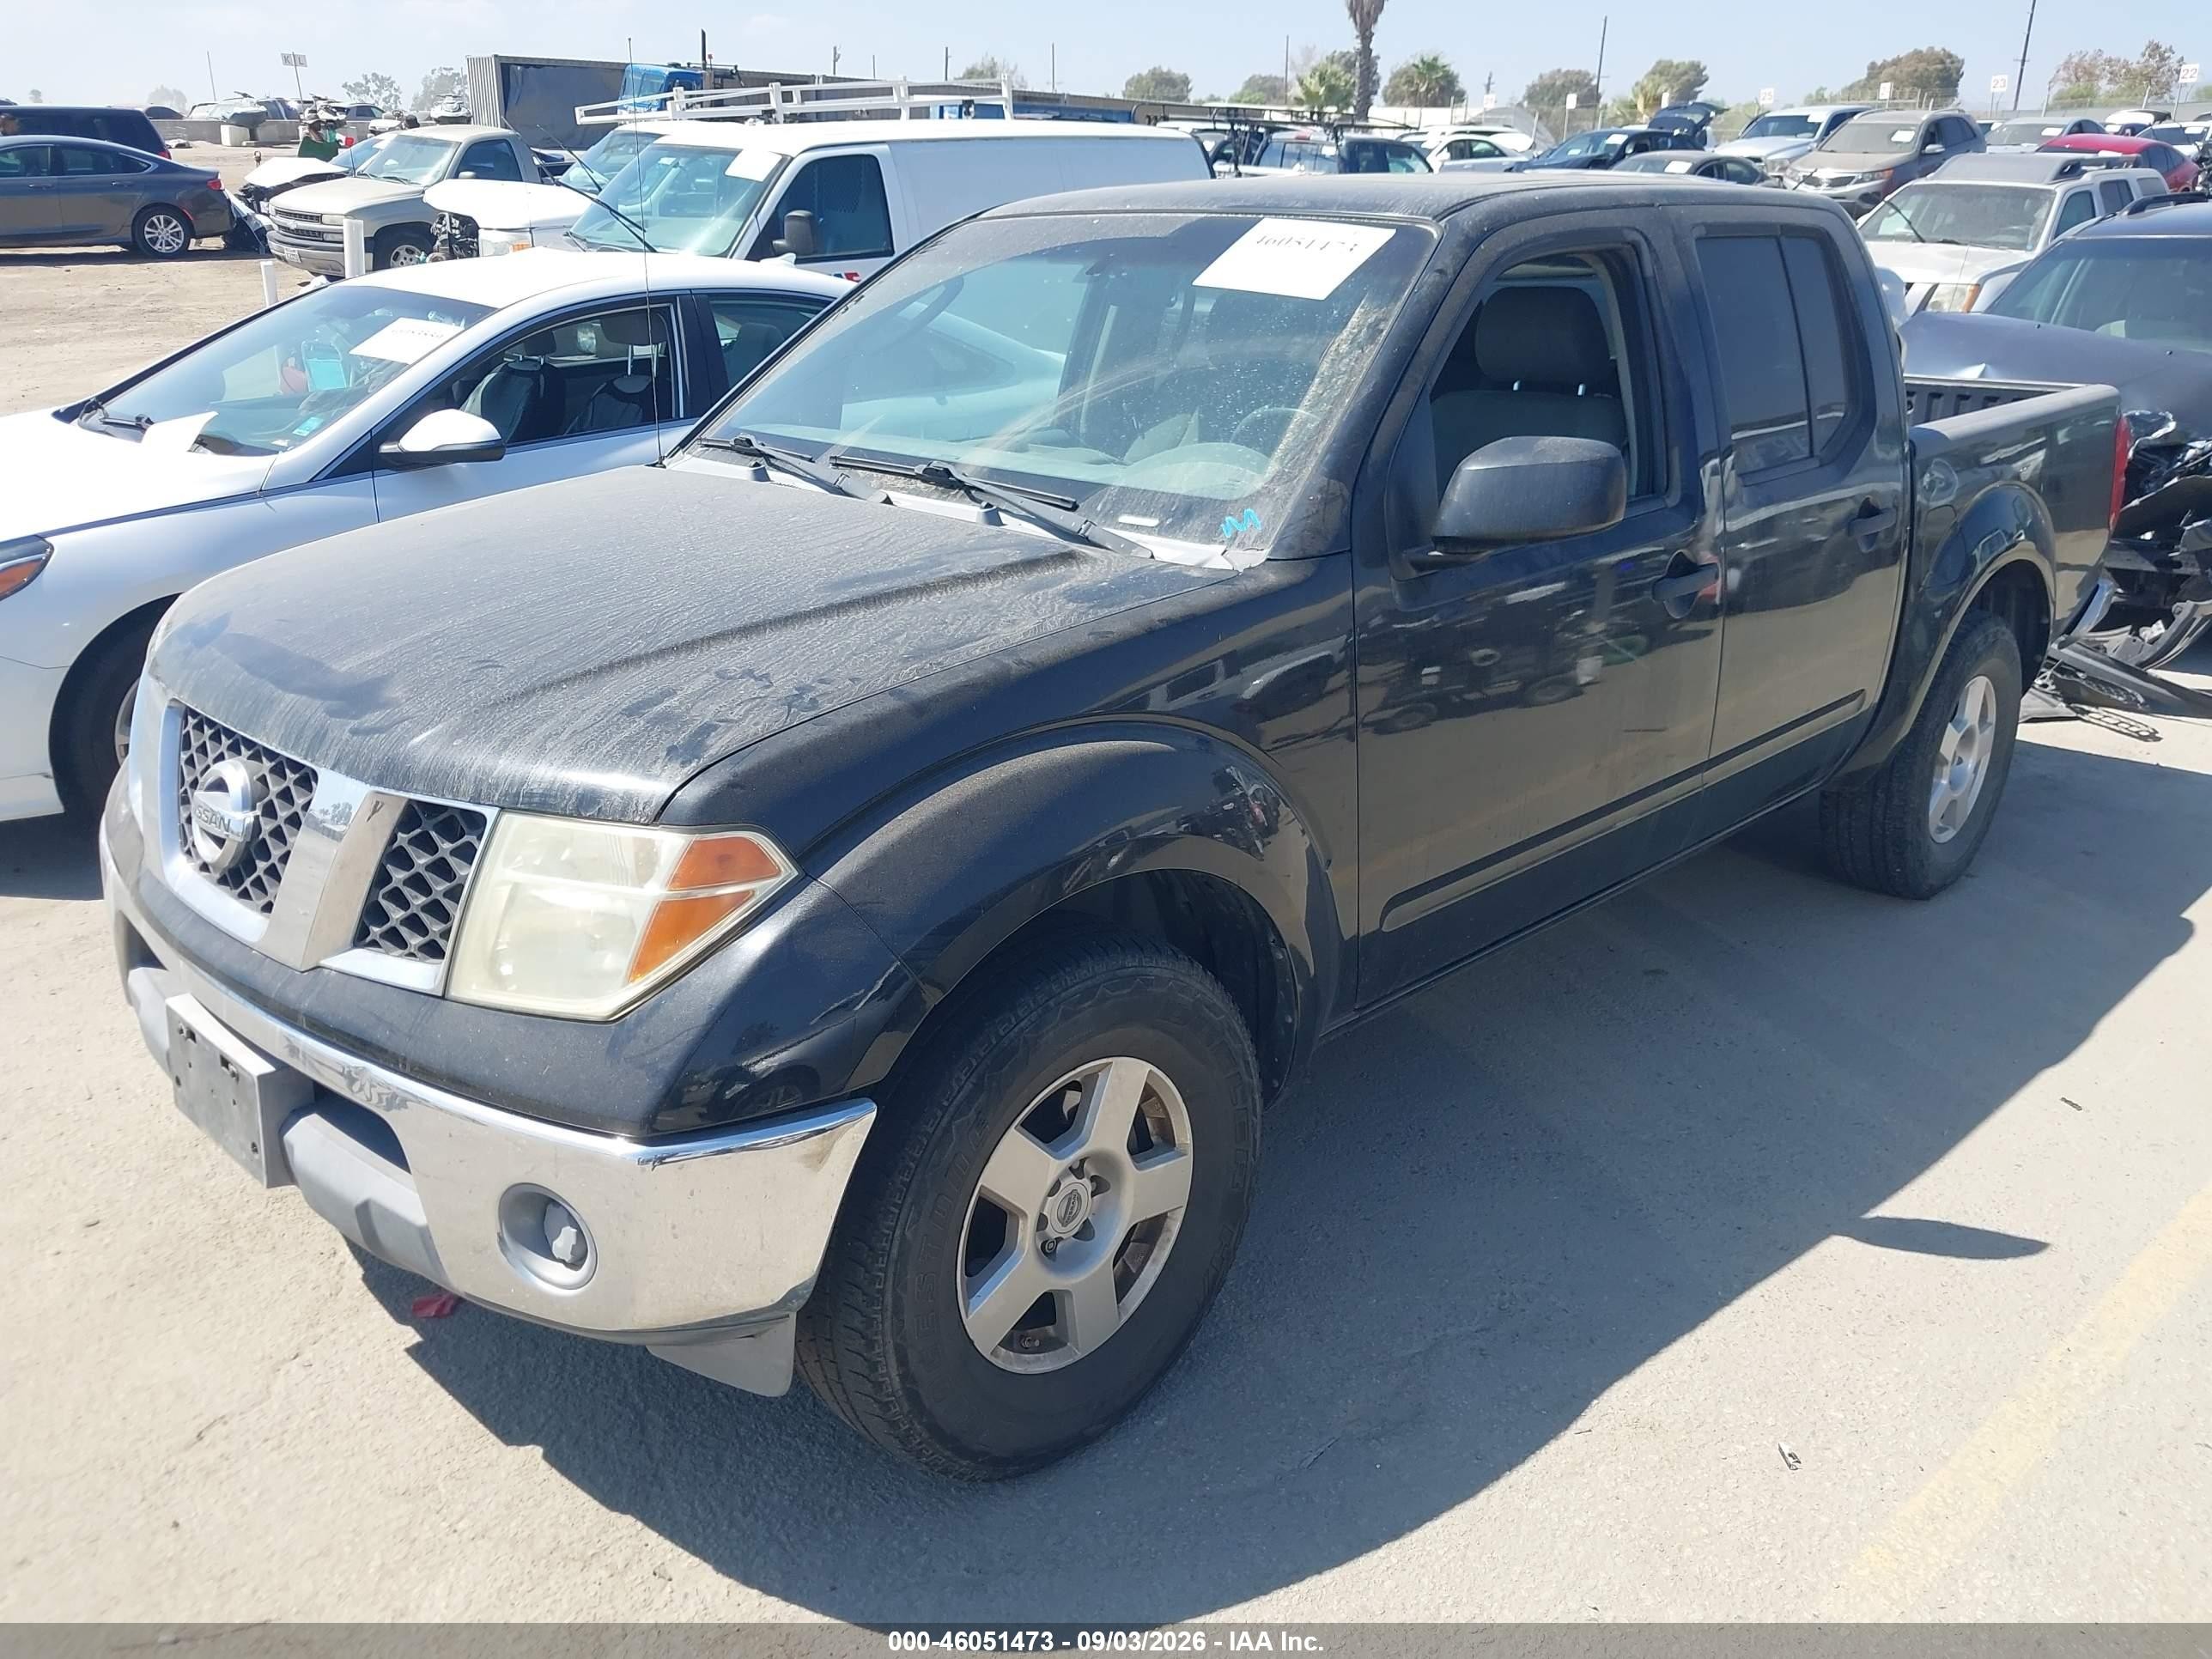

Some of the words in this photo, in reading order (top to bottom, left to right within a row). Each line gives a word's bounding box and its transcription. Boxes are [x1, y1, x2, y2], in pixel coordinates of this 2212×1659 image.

[283, 55, 290, 64] K
[2181, 68, 2198, 79] 22
[1992, 78, 2006, 88] 23
